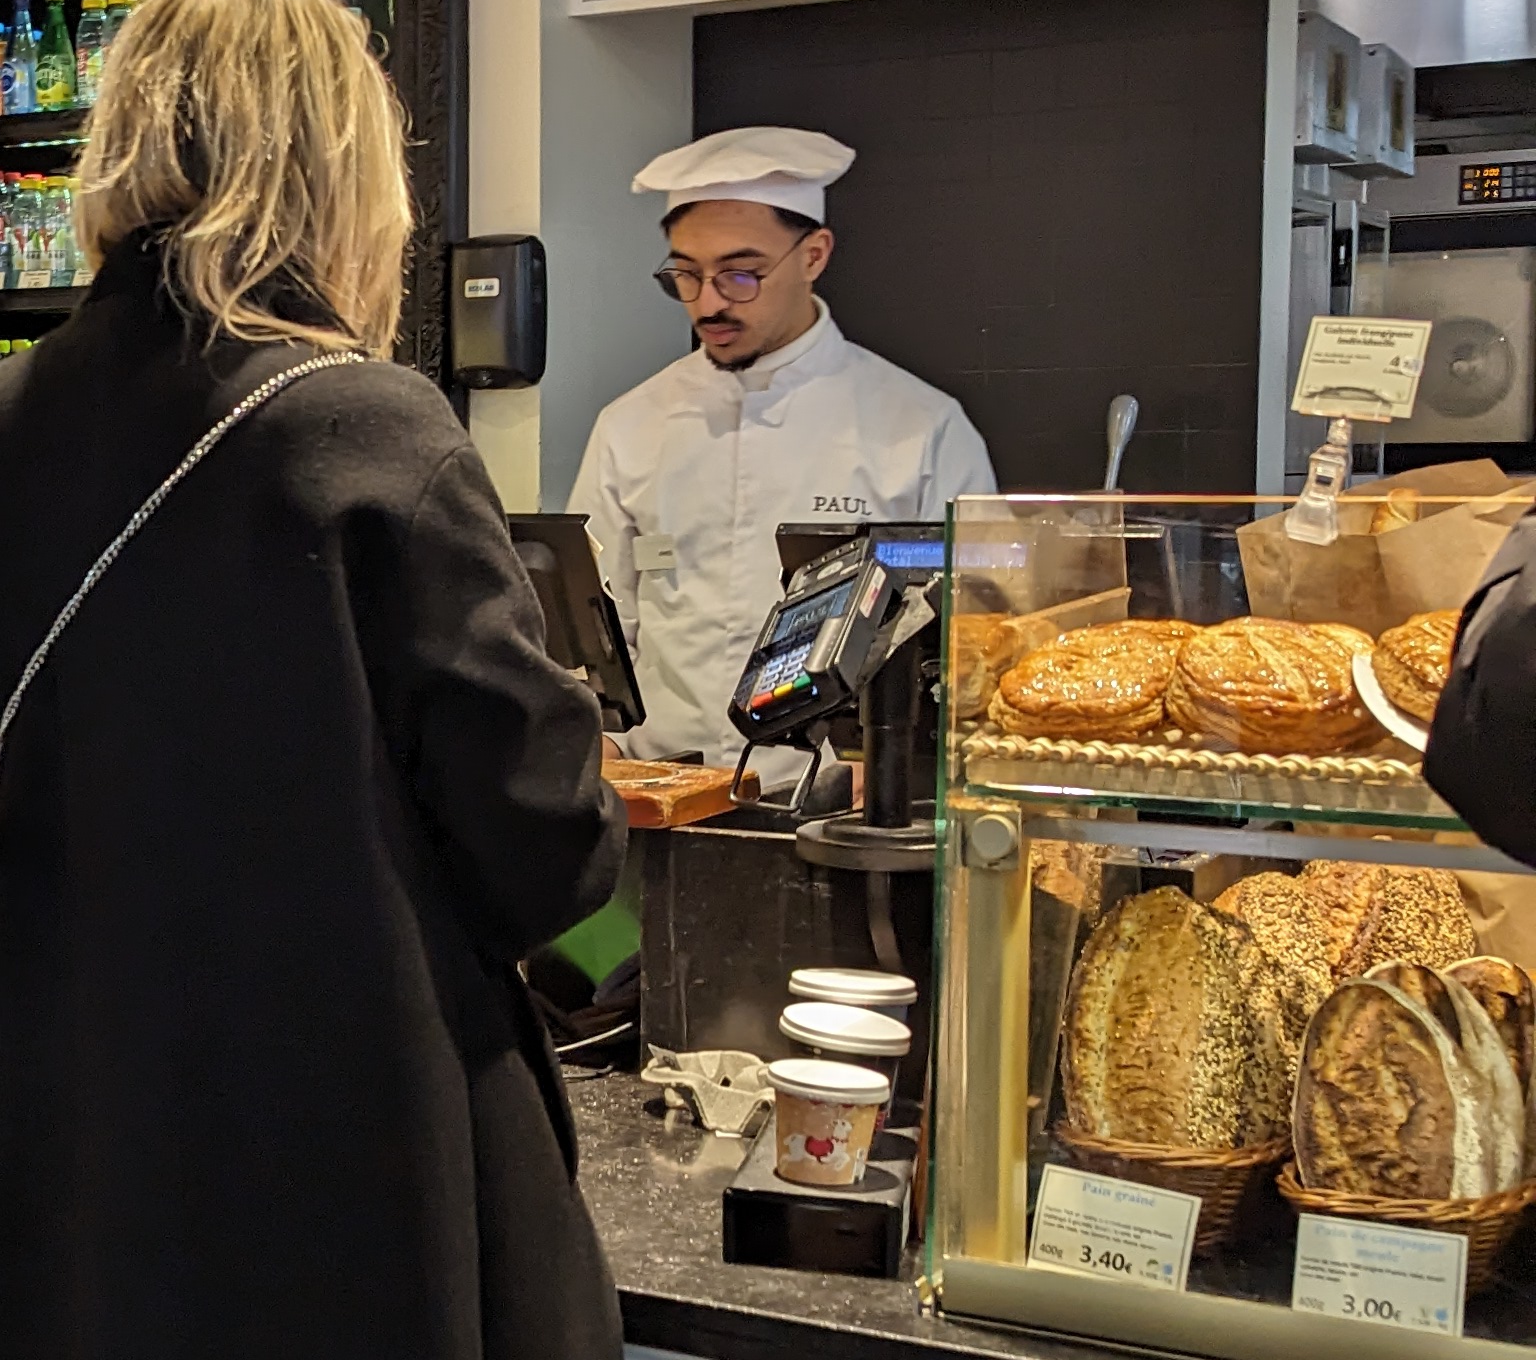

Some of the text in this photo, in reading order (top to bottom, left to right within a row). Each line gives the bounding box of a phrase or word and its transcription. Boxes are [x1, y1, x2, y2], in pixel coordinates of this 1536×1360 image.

[812, 496, 873, 516] PAUL
[1082, 1182, 1112, 1197] Pain
[1039, 1242, 1133, 1275] 400g 3,40€
[1342, 1294, 1402, 1322] 3,00€
